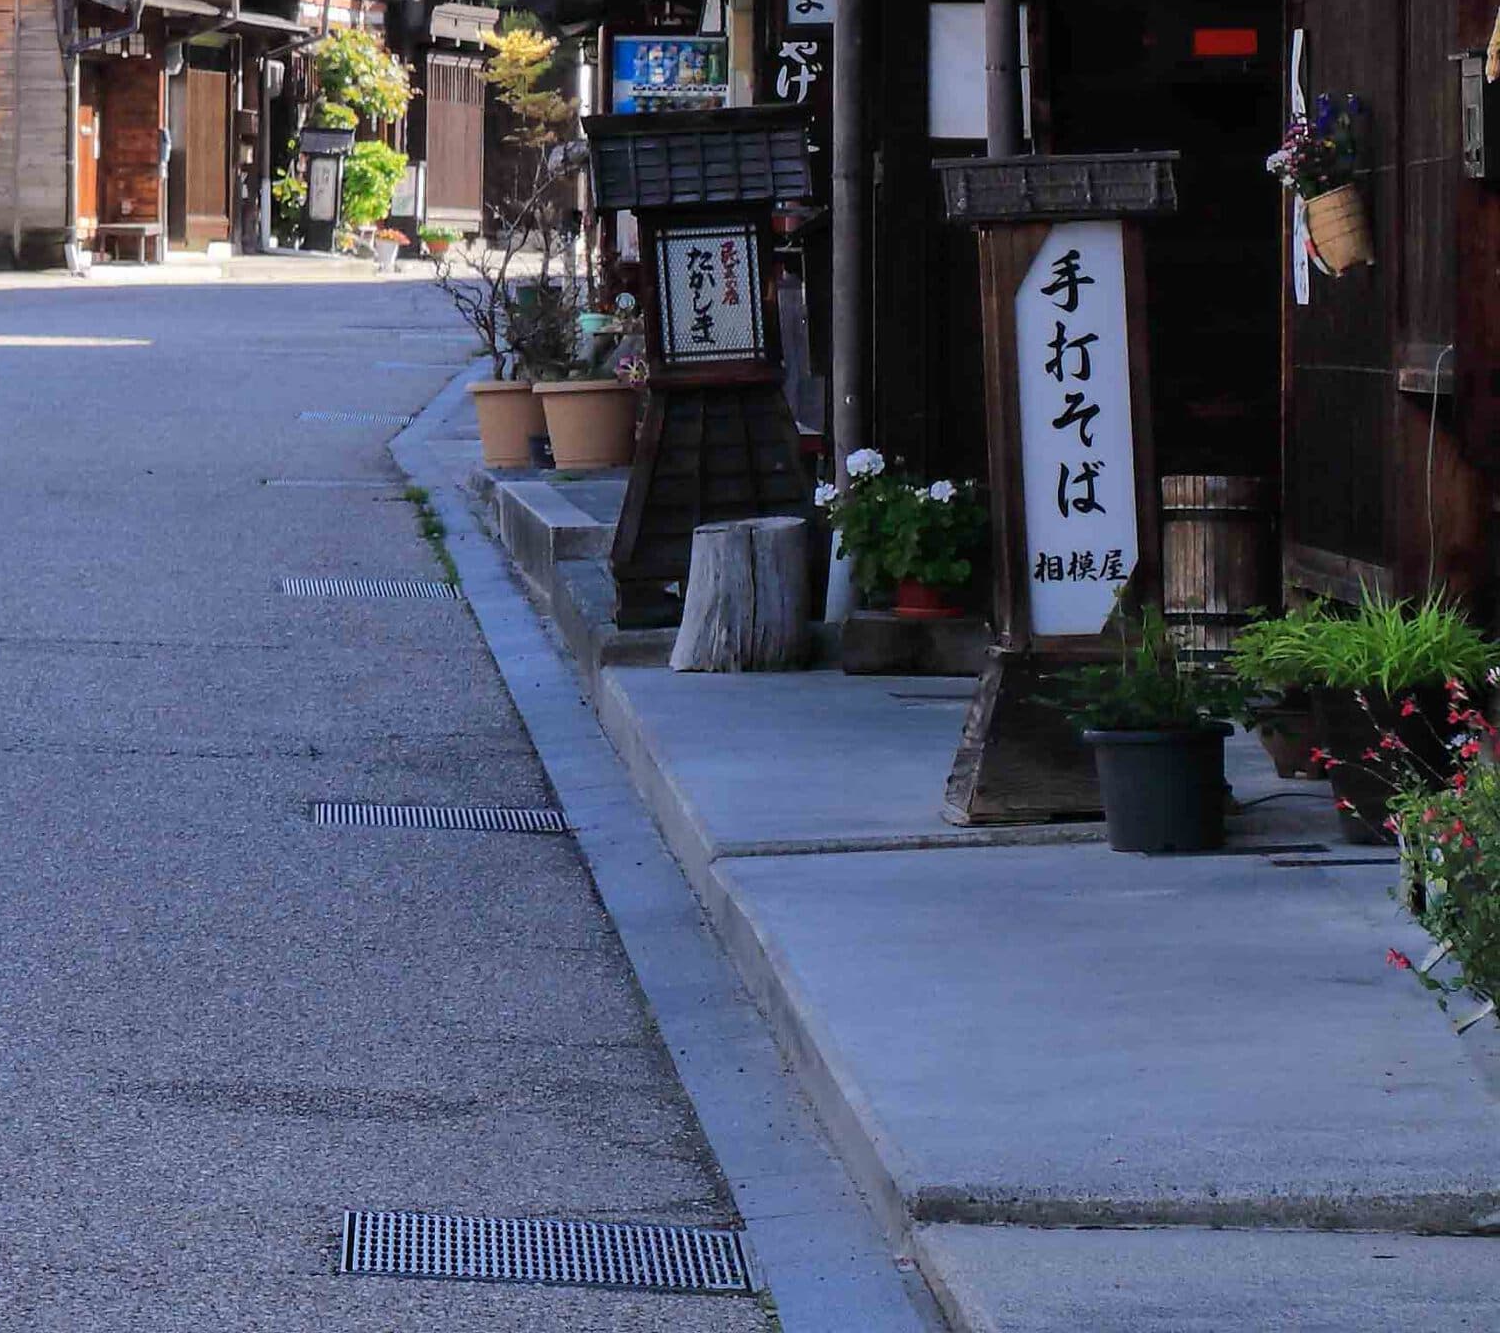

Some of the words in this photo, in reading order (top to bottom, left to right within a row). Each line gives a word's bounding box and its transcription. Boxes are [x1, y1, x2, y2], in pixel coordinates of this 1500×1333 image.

[685, 246, 717, 346] たかしま
[1039, 248, 1108, 520] 手打そば
[1033, 548, 1129, 585] 相模屋
